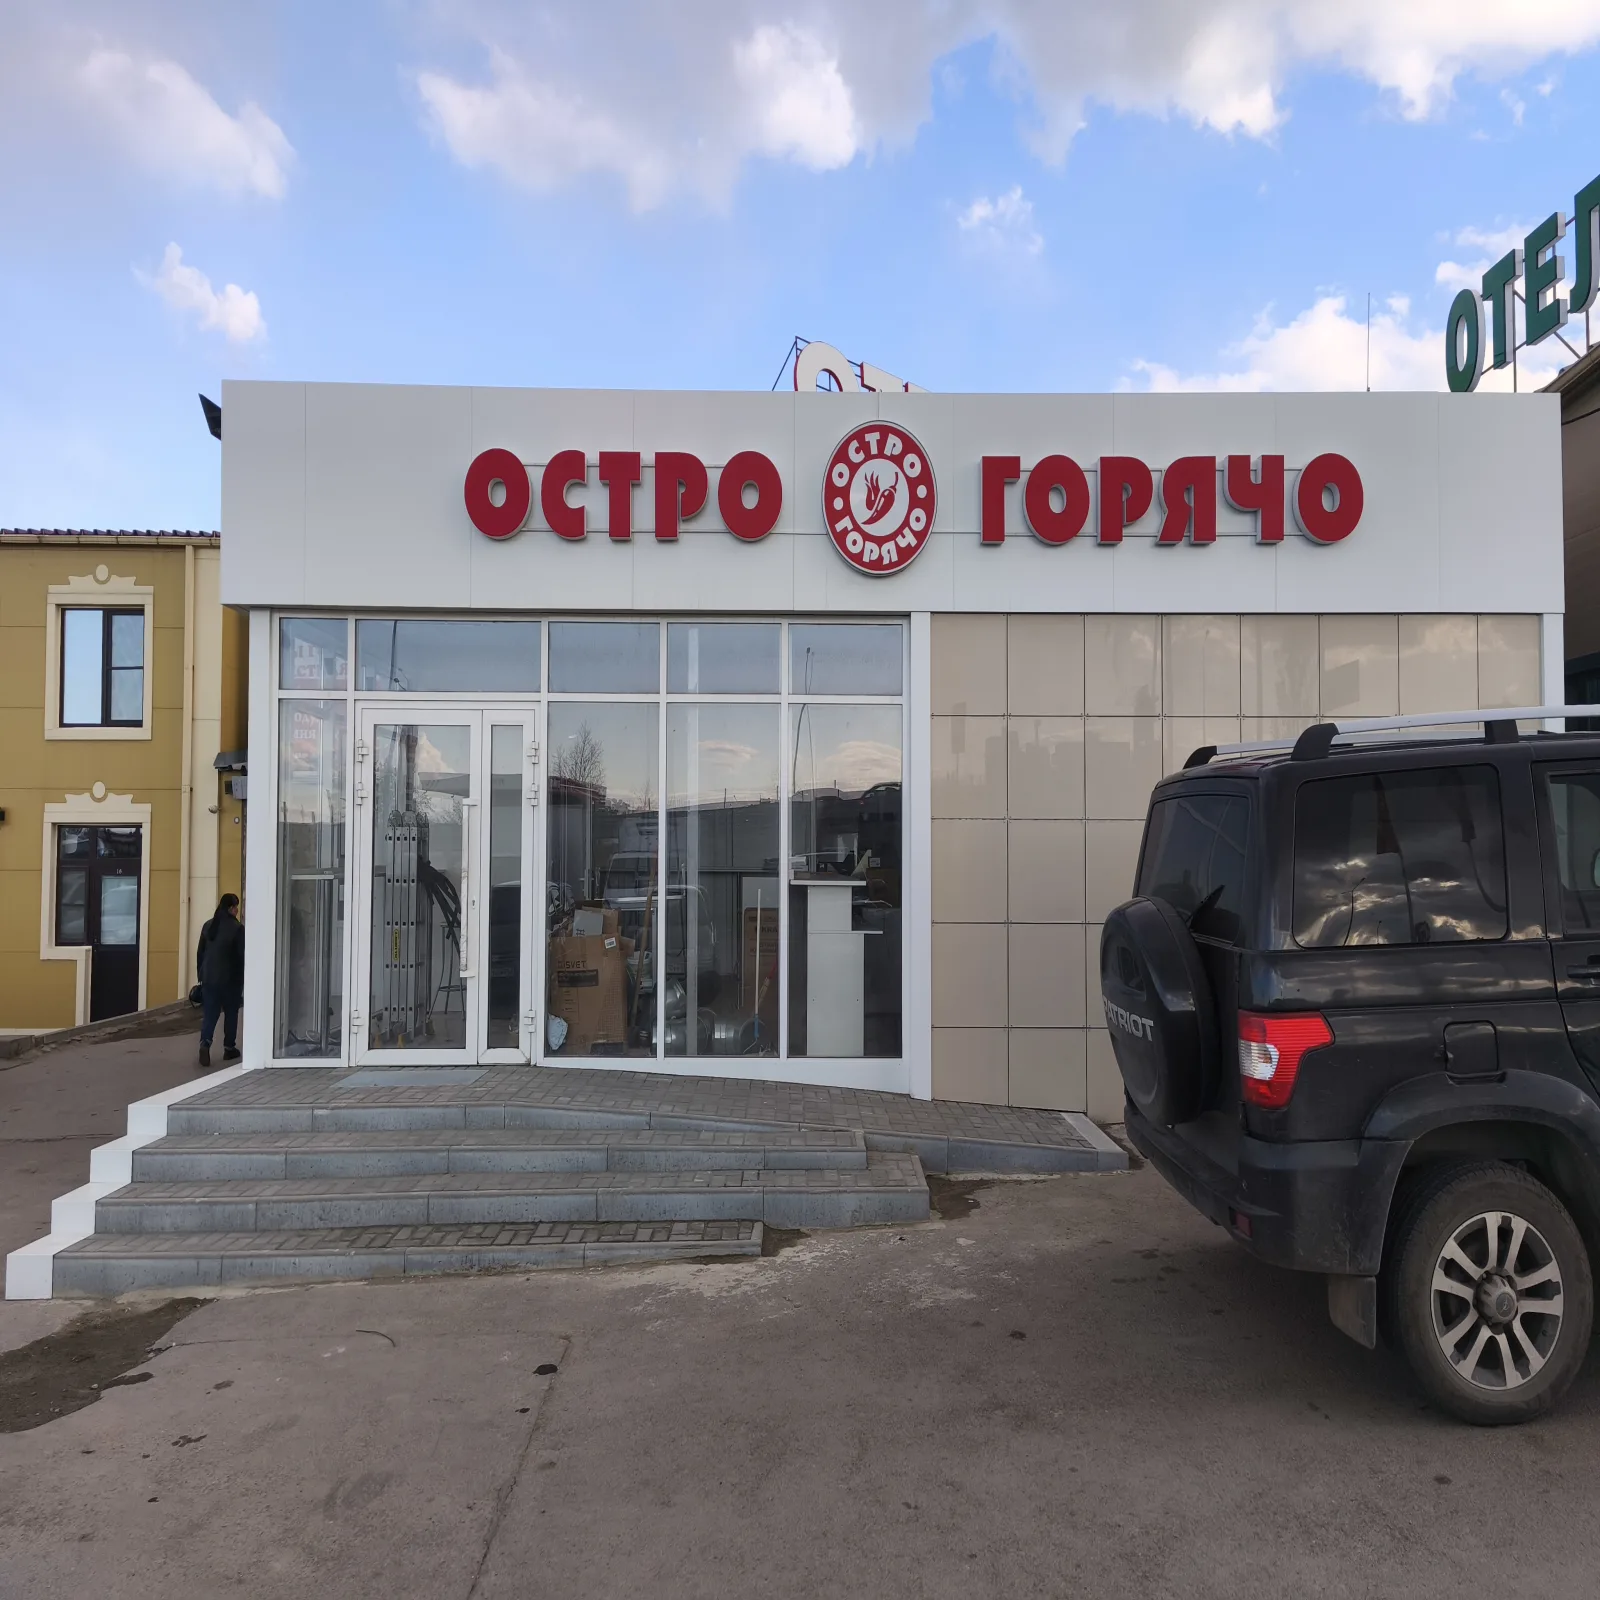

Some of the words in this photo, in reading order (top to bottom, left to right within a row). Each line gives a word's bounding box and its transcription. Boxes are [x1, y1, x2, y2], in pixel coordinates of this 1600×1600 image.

[464, 447, 782, 542] ОСТРО
[831, 431, 922, 488] ОСТРО
[834, 507, 927, 565] ГОРЯЧО
[980, 452, 1364, 546] ГОРЯЧО
